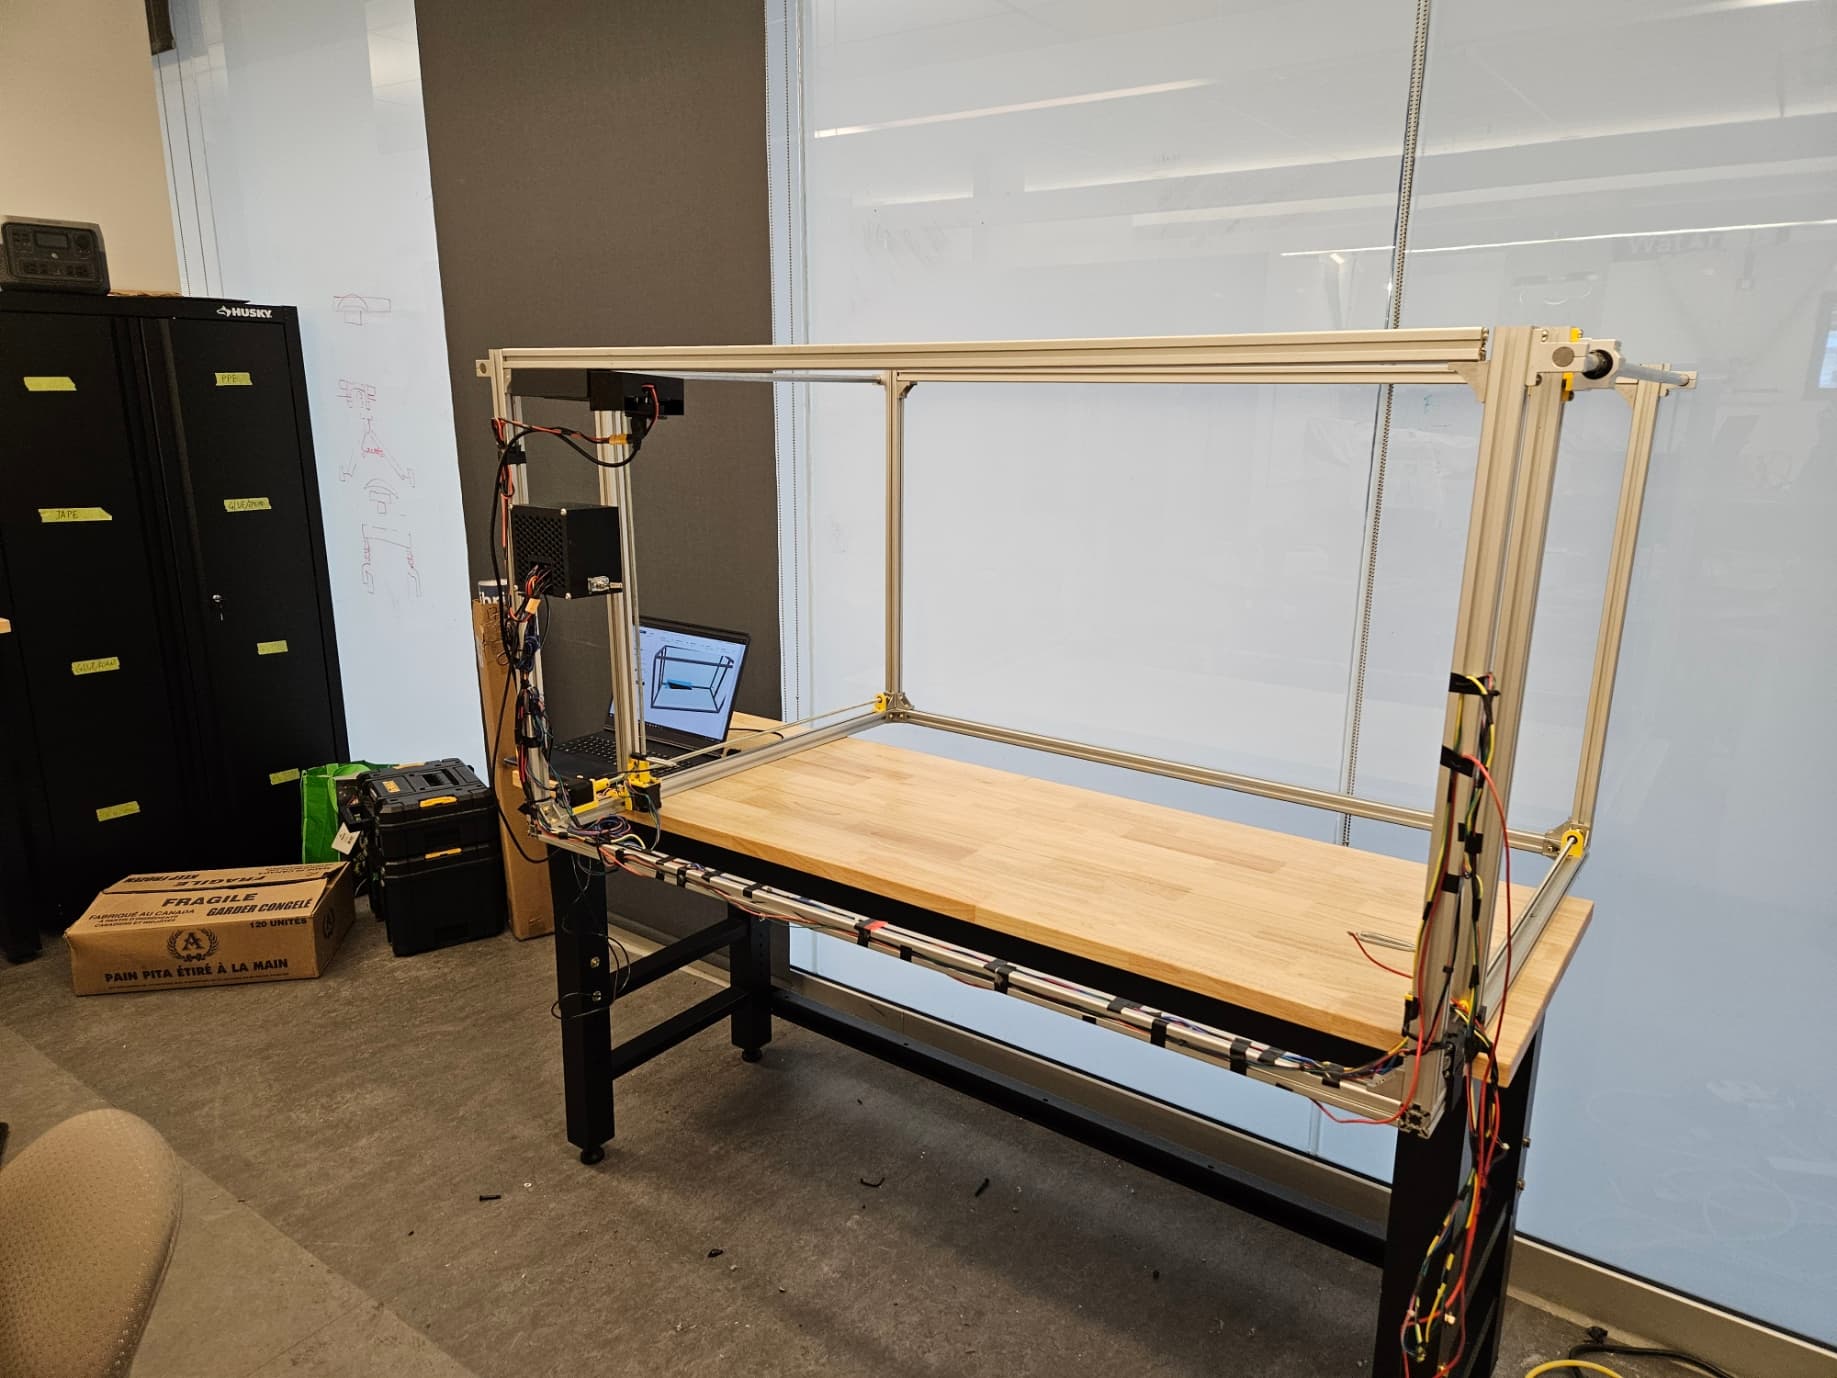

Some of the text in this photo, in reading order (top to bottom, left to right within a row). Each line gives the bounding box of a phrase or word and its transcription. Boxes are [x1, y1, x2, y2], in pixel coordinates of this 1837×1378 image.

[231, 307, 272, 318] HUSKY
[174, 875, 266, 887] FRAGILE
[161, 892, 258, 907] FRAGILE
[154, 909, 195, 917] CANADA
[206, 902, 259, 917] GARDER
[249, 920, 267, 928] 120
[183, 932, 203, 951] A
[104, 959, 288, 983] PAIN PITA ÉTIRÉ À LA MAIN
